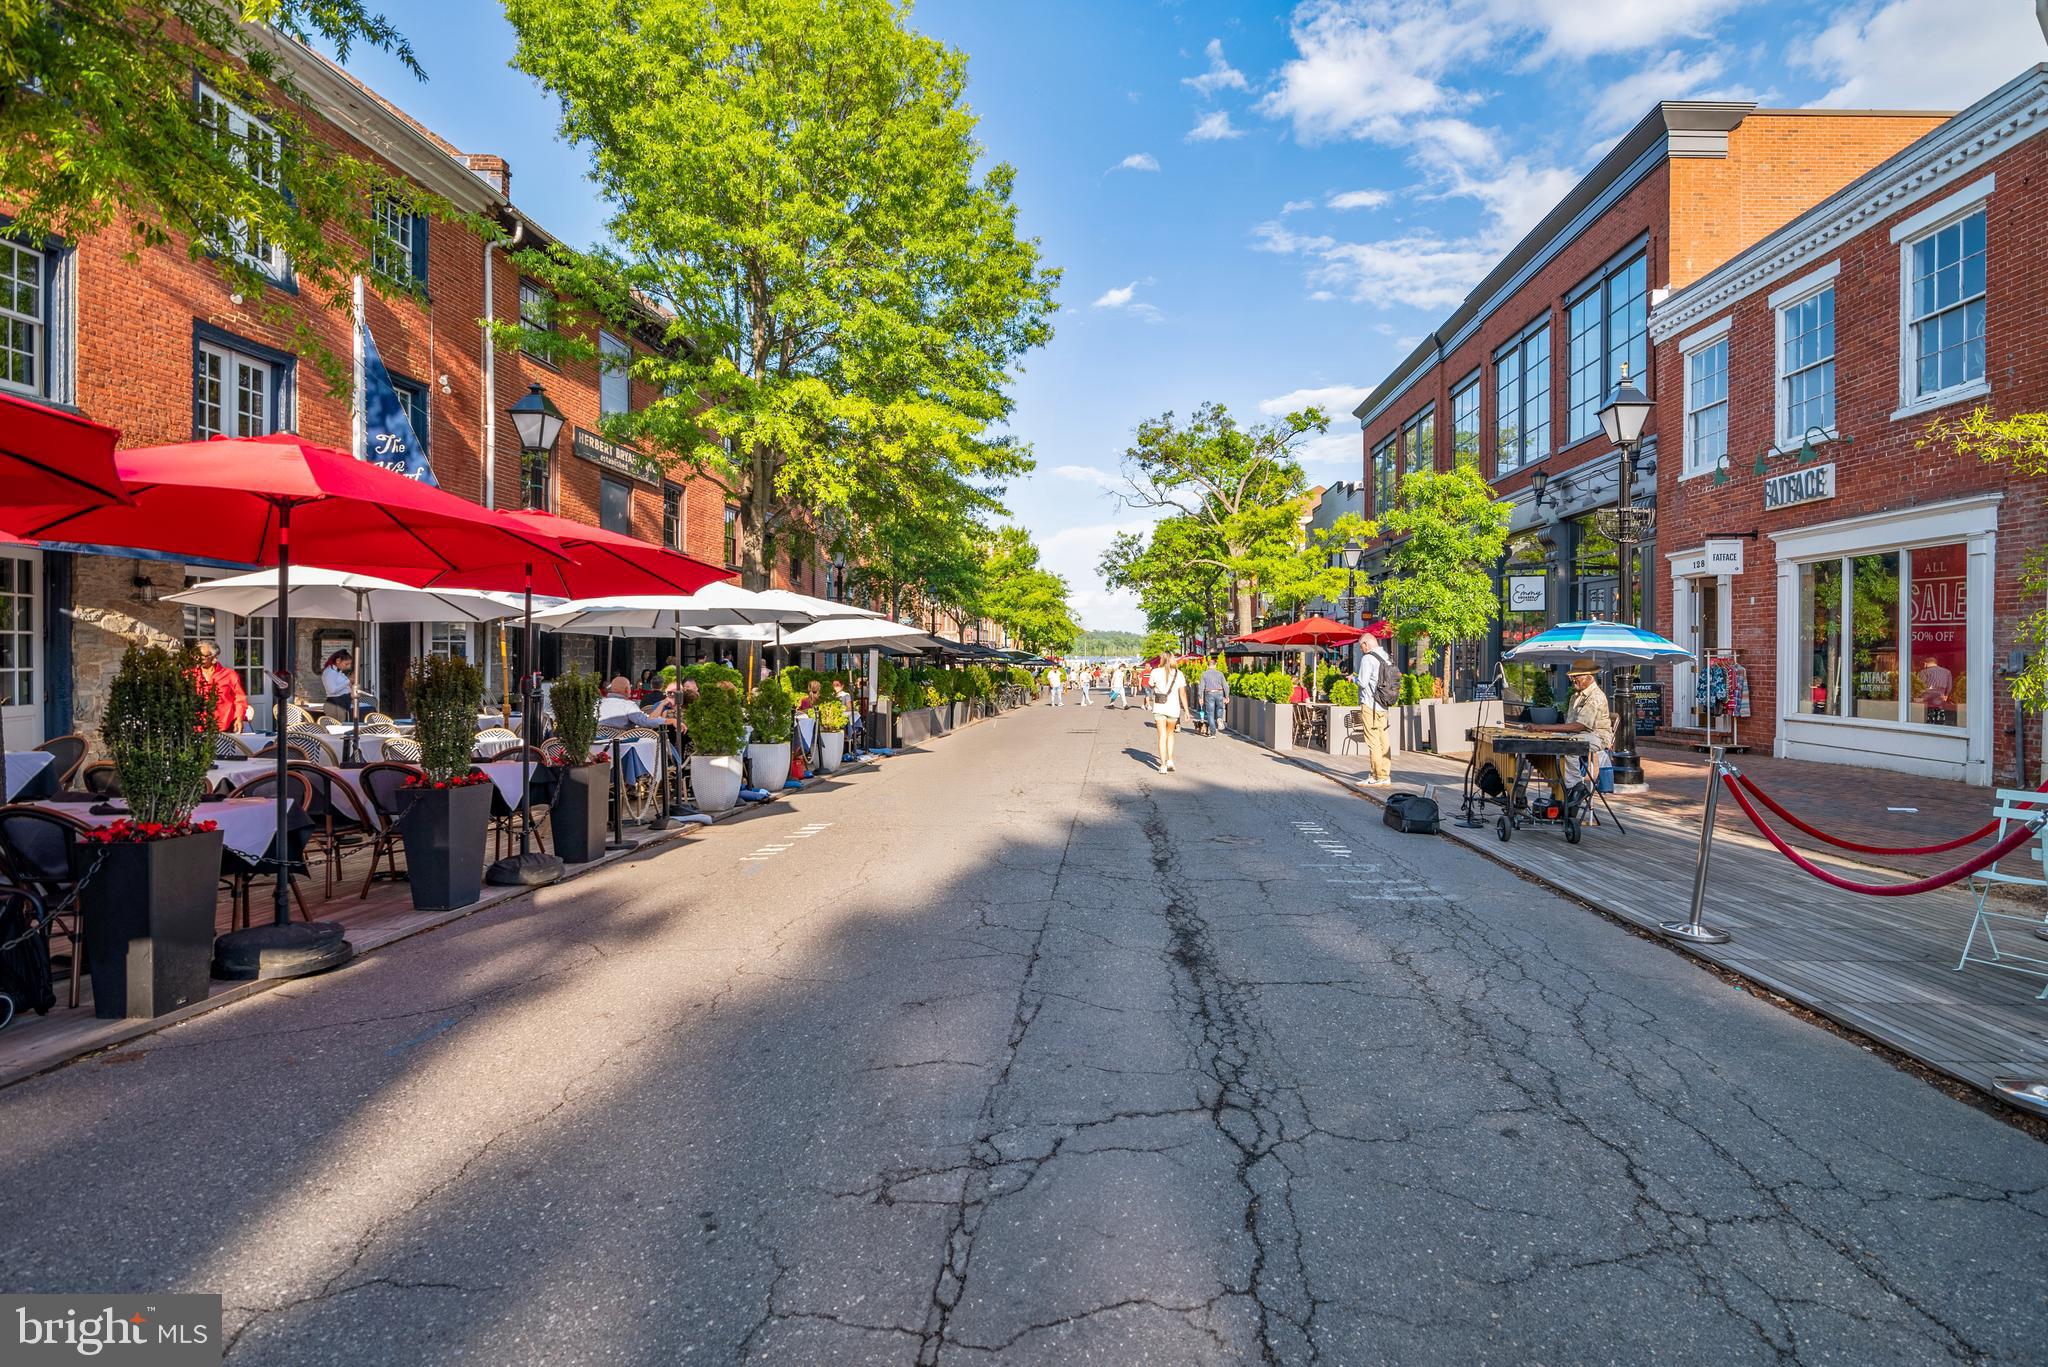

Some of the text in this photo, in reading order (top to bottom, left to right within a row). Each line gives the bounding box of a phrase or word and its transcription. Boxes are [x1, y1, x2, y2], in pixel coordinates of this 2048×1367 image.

[375, 434, 406, 454] The
[578, 431, 613, 456] HERBERT
[1764, 467, 1829, 507] FATFACE
[1693, 559, 1706, 569] 128
[1712, 553, 1737, 561] FATFACE
[1924, 561, 1947, 573] ALL
[1512, 583, 1543, 604] Emmy
[1911, 582, 1967, 621] SALE
[1911, 631, 1955, 642] 50% OFF
